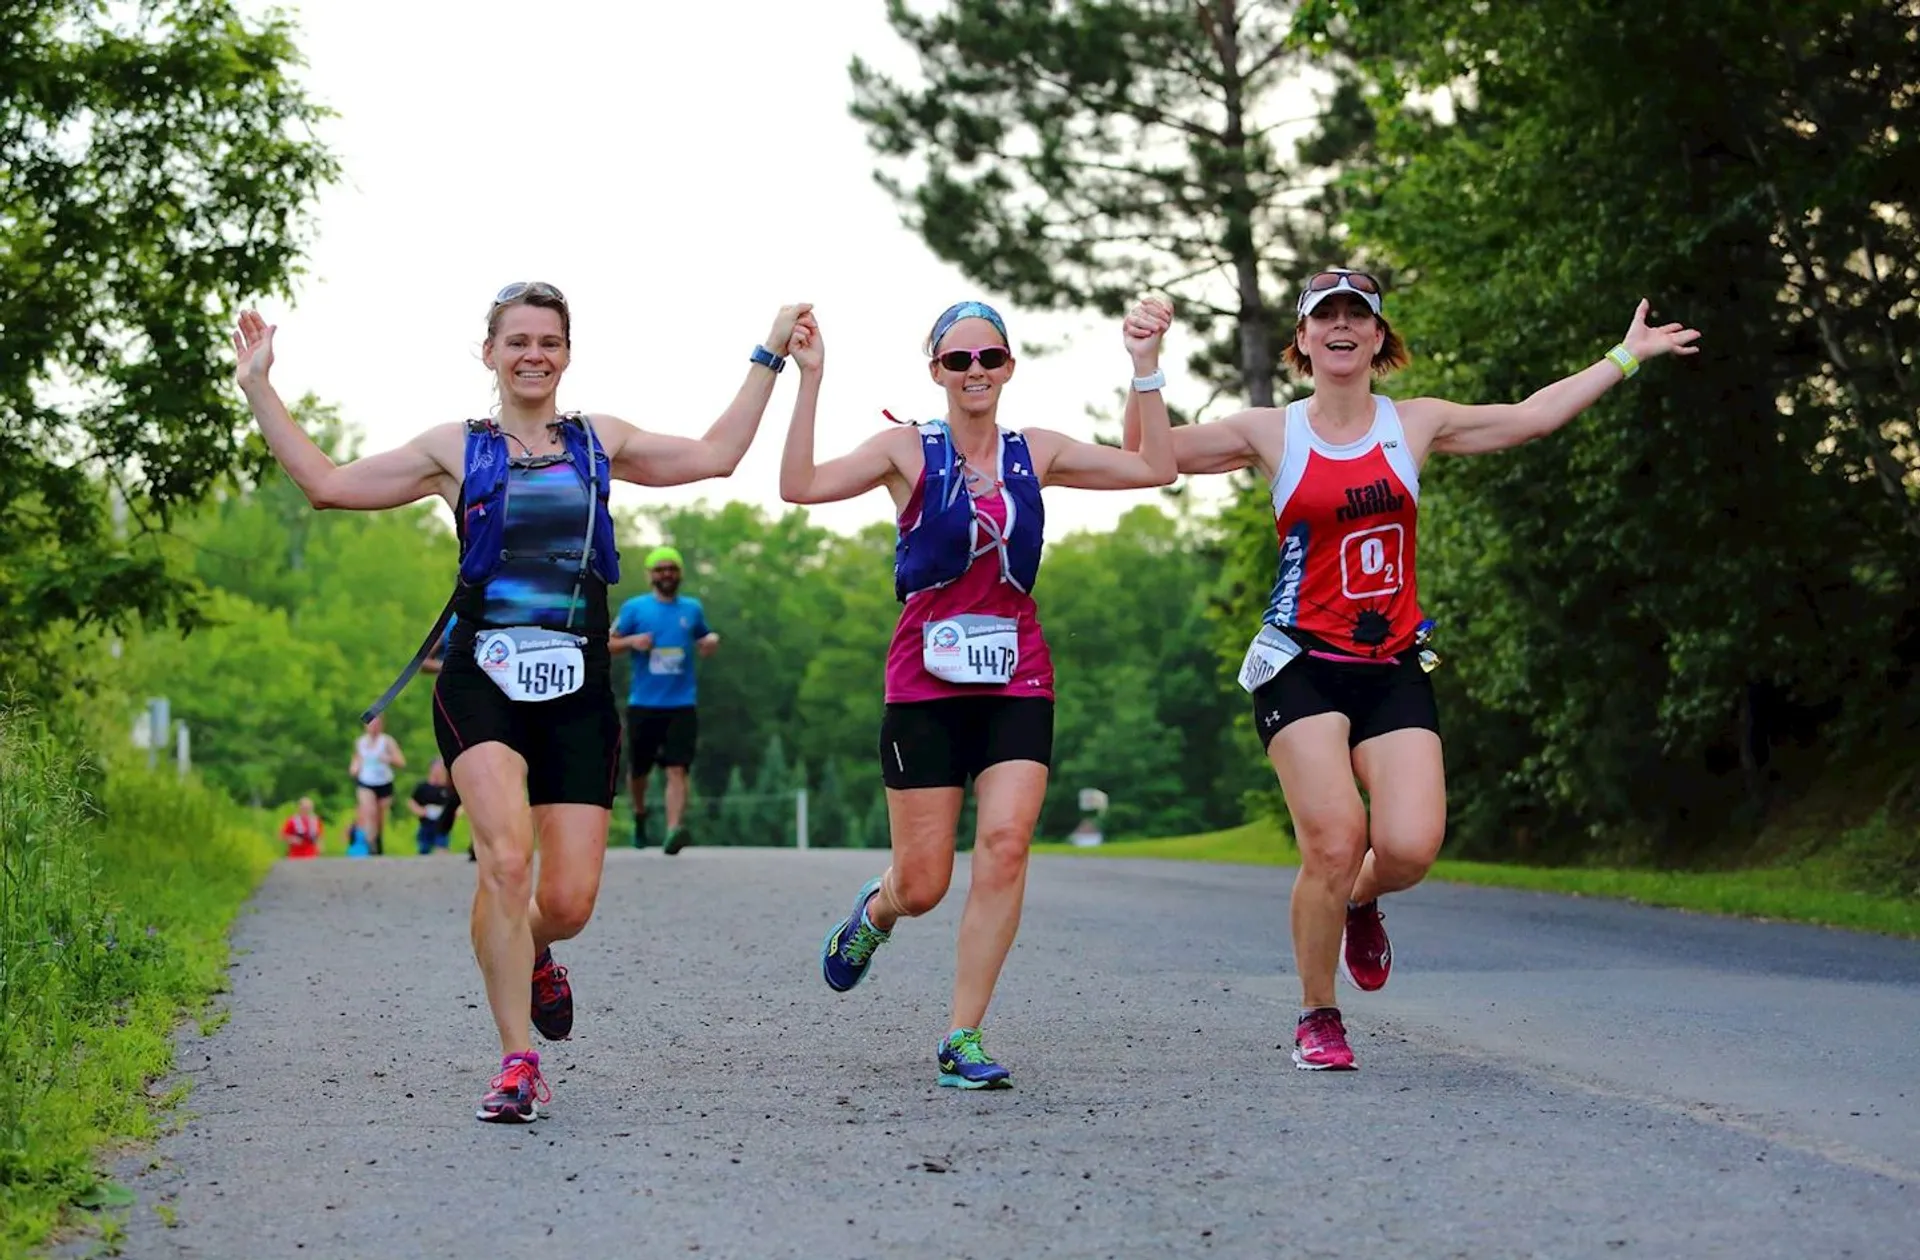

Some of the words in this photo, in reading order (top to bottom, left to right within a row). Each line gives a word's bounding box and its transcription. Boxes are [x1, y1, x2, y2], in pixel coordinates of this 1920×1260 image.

[1345, 478, 1392, 505] trail
[1336, 494, 1404, 523] runner
[967, 645, 1015, 678] 4472
[517, 661, 575, 695] 4541
